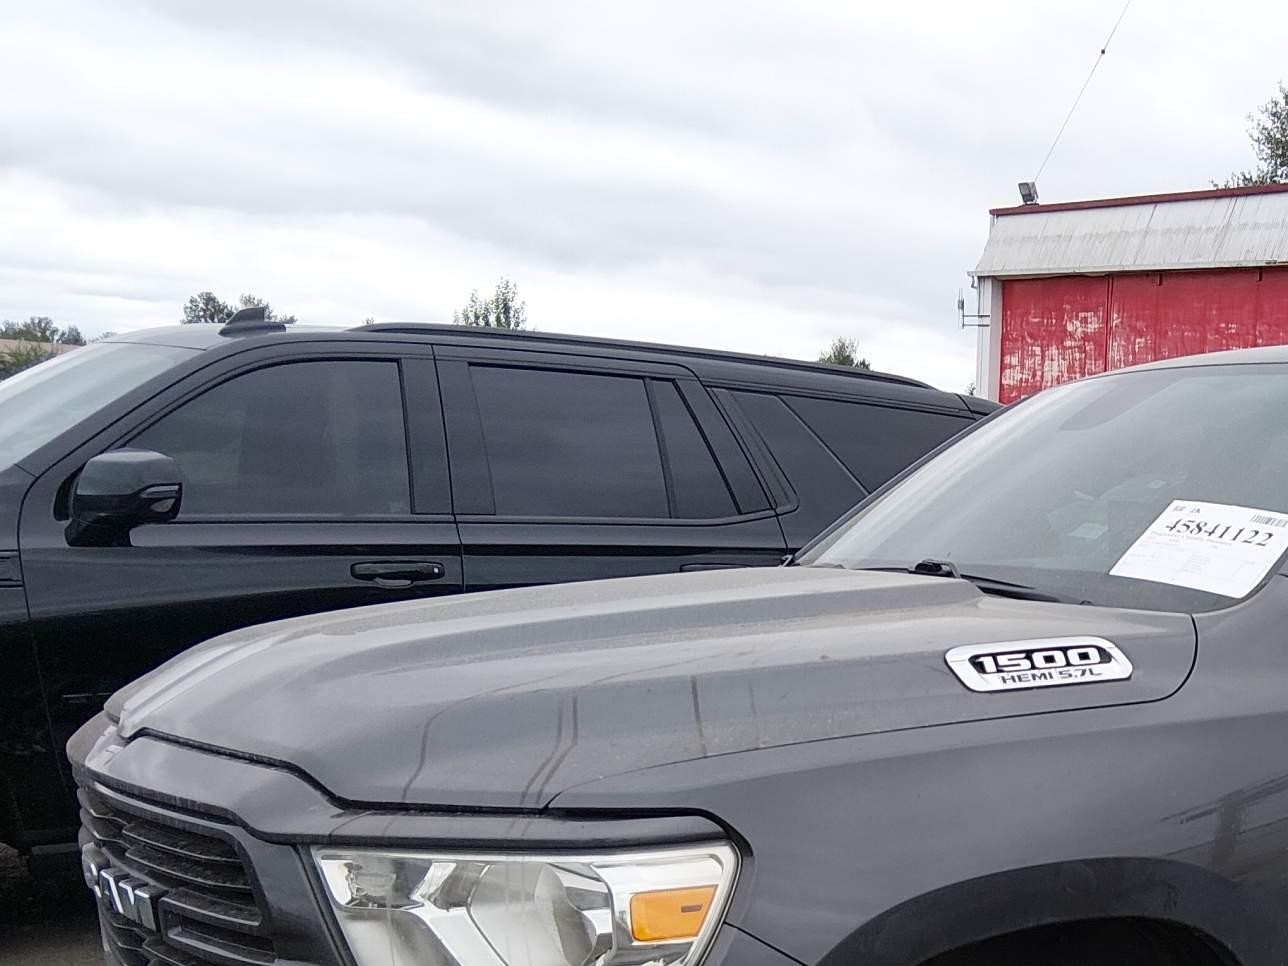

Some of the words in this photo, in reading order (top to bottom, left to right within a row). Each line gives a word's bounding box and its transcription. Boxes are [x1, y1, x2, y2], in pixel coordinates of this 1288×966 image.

[1165, 518, 1274, 547] 45841122
[975, 647, 1101, 673] 1500
[1000, 672, 1054, 684] HEMI
[1057, 668, 1102, 679] 5.7L
